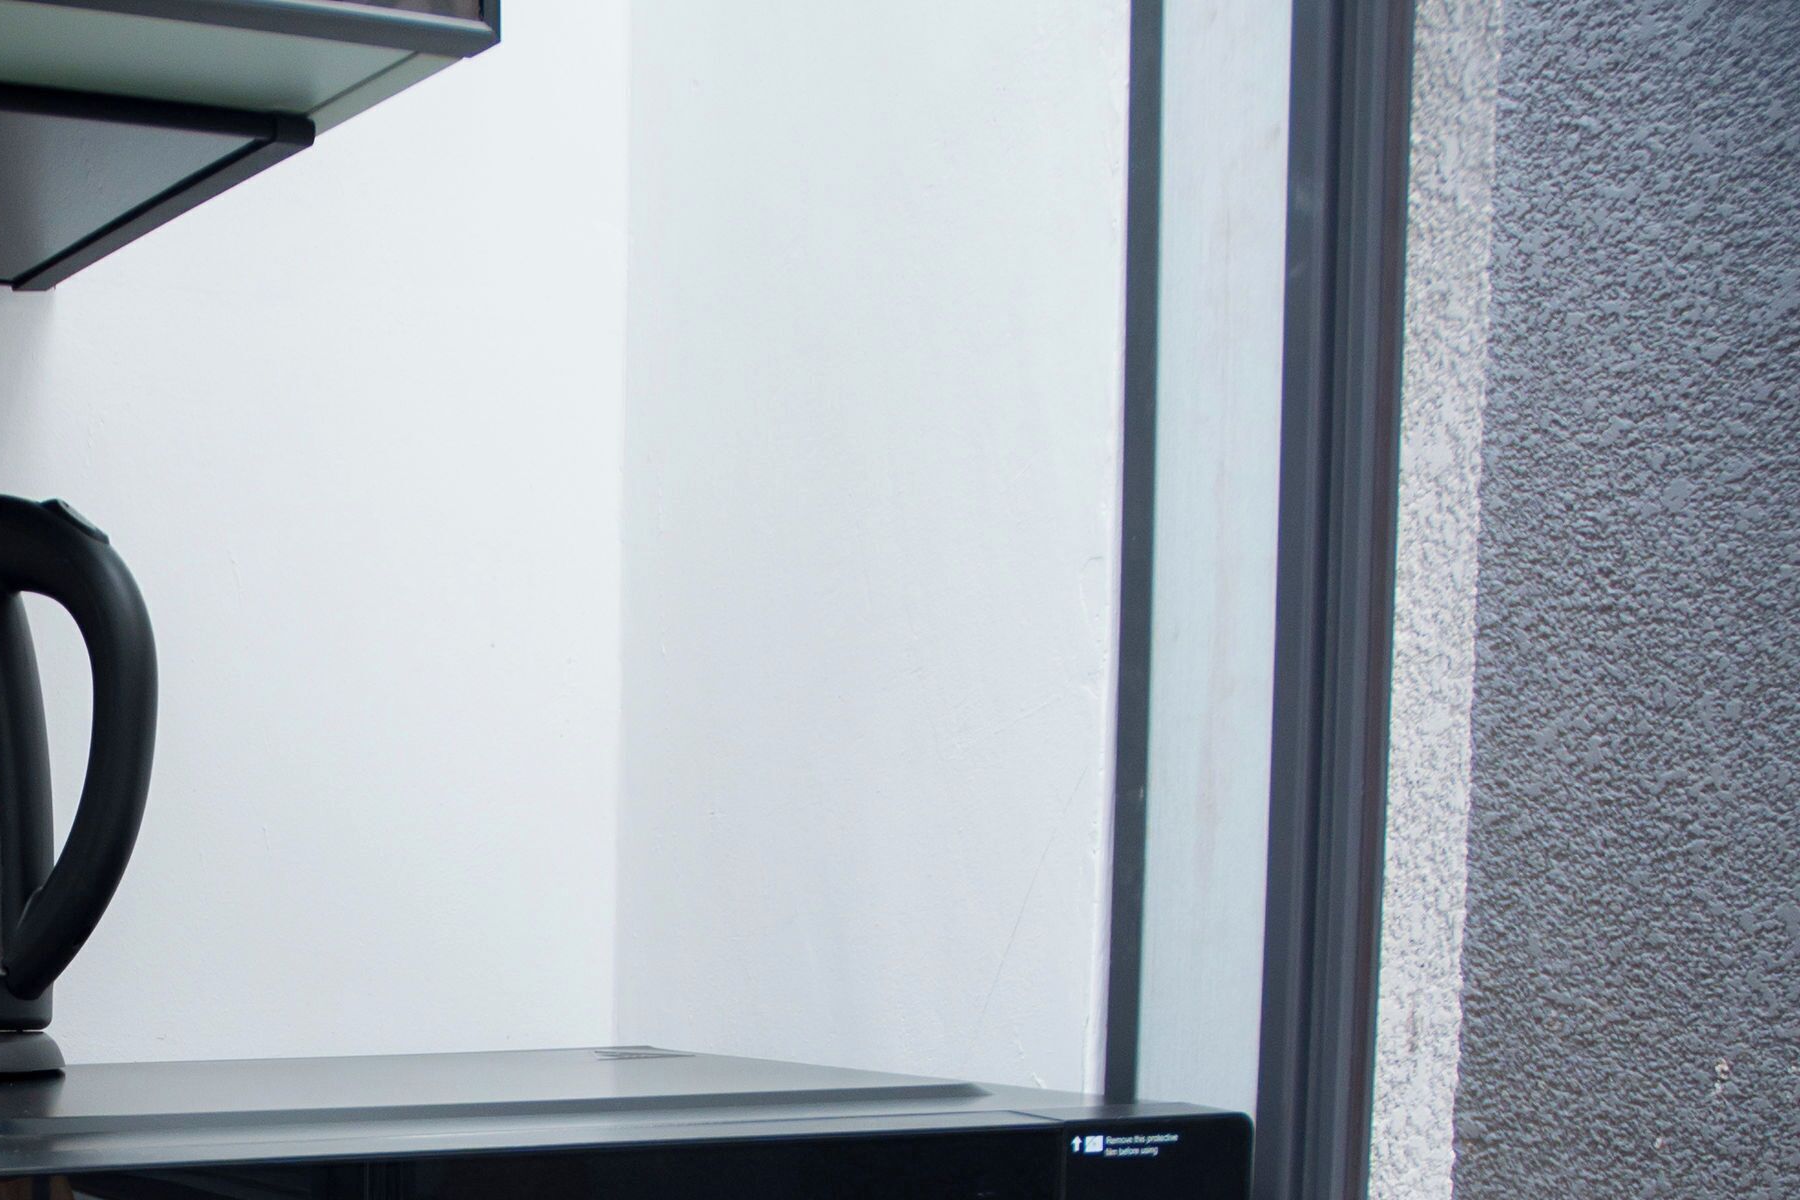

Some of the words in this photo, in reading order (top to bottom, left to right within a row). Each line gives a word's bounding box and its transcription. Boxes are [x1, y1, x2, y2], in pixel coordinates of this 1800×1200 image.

[1106, 1135, 1132, 1145] Remove
[1134, 1134, 1145, 1144] this
[1146, 1133, 1179, 1144] protective
[1118, 1147, 1140, 1157] before
[1140, 1146, 1159, 1156] using
